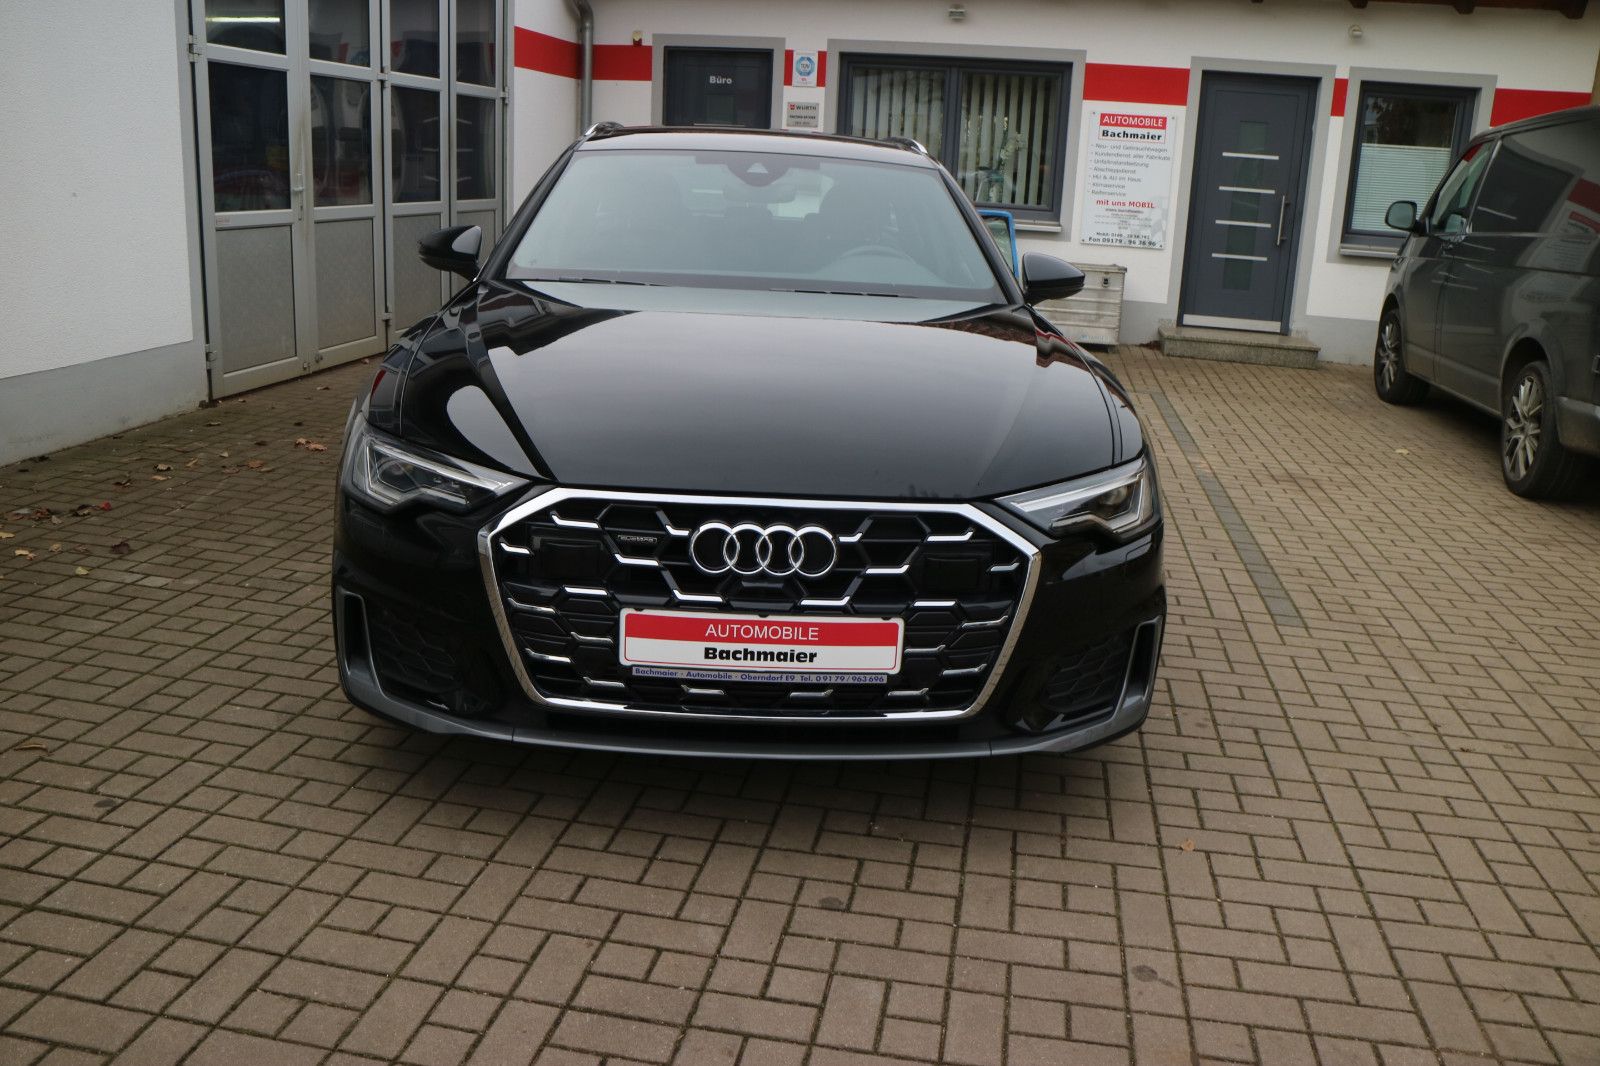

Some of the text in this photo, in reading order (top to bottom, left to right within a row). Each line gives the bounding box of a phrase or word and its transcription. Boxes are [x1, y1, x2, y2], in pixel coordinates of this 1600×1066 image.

[709, 75, 732, 84] Büro
[1103, 115, 1163, 127] AUTOMOBILE
[1102, 130, 1162, 141] Bachmaier
[705, 624, 819, 640] AUTOMOBILE
[704, 647, 817, 662] Bachmaier
[635, 668, 678, 677] Bachmaier
[686, 671, 732, 680] Automobile
